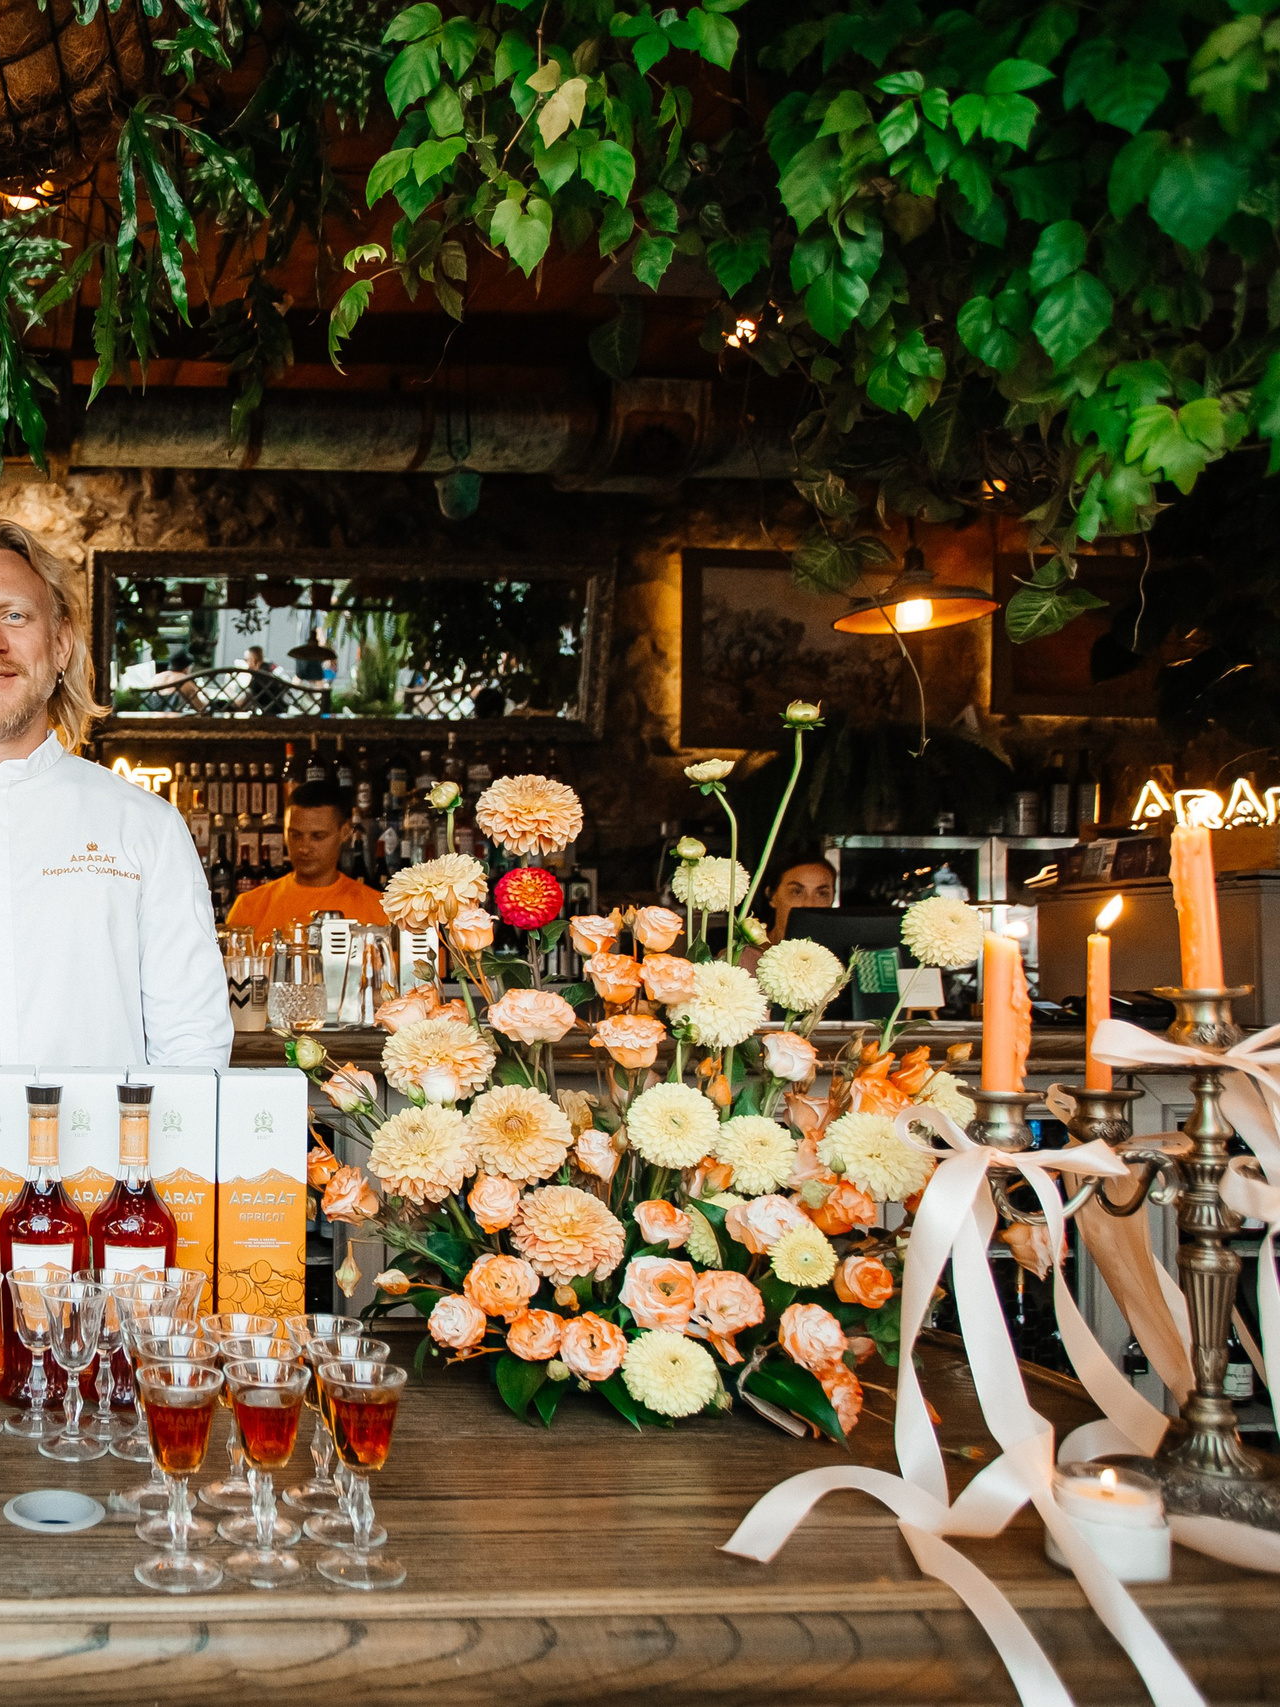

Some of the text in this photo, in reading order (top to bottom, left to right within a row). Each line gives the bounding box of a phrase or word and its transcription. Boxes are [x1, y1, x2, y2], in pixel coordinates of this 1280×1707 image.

[1131, 778, 1280, 830] ARA
[70, 853, 117, 864] ARARAT
[42, 864, 141, 882] Кирилл Сударьков
[71, 1188, 109, 1203] ARA
[162, 1189, 206, 1205] ARAT
[229, 1190, 297, 1206] ARARAT
[173, 1212, 194, 1222] COT
[239, 1212, 286, 1223] APRICOT
